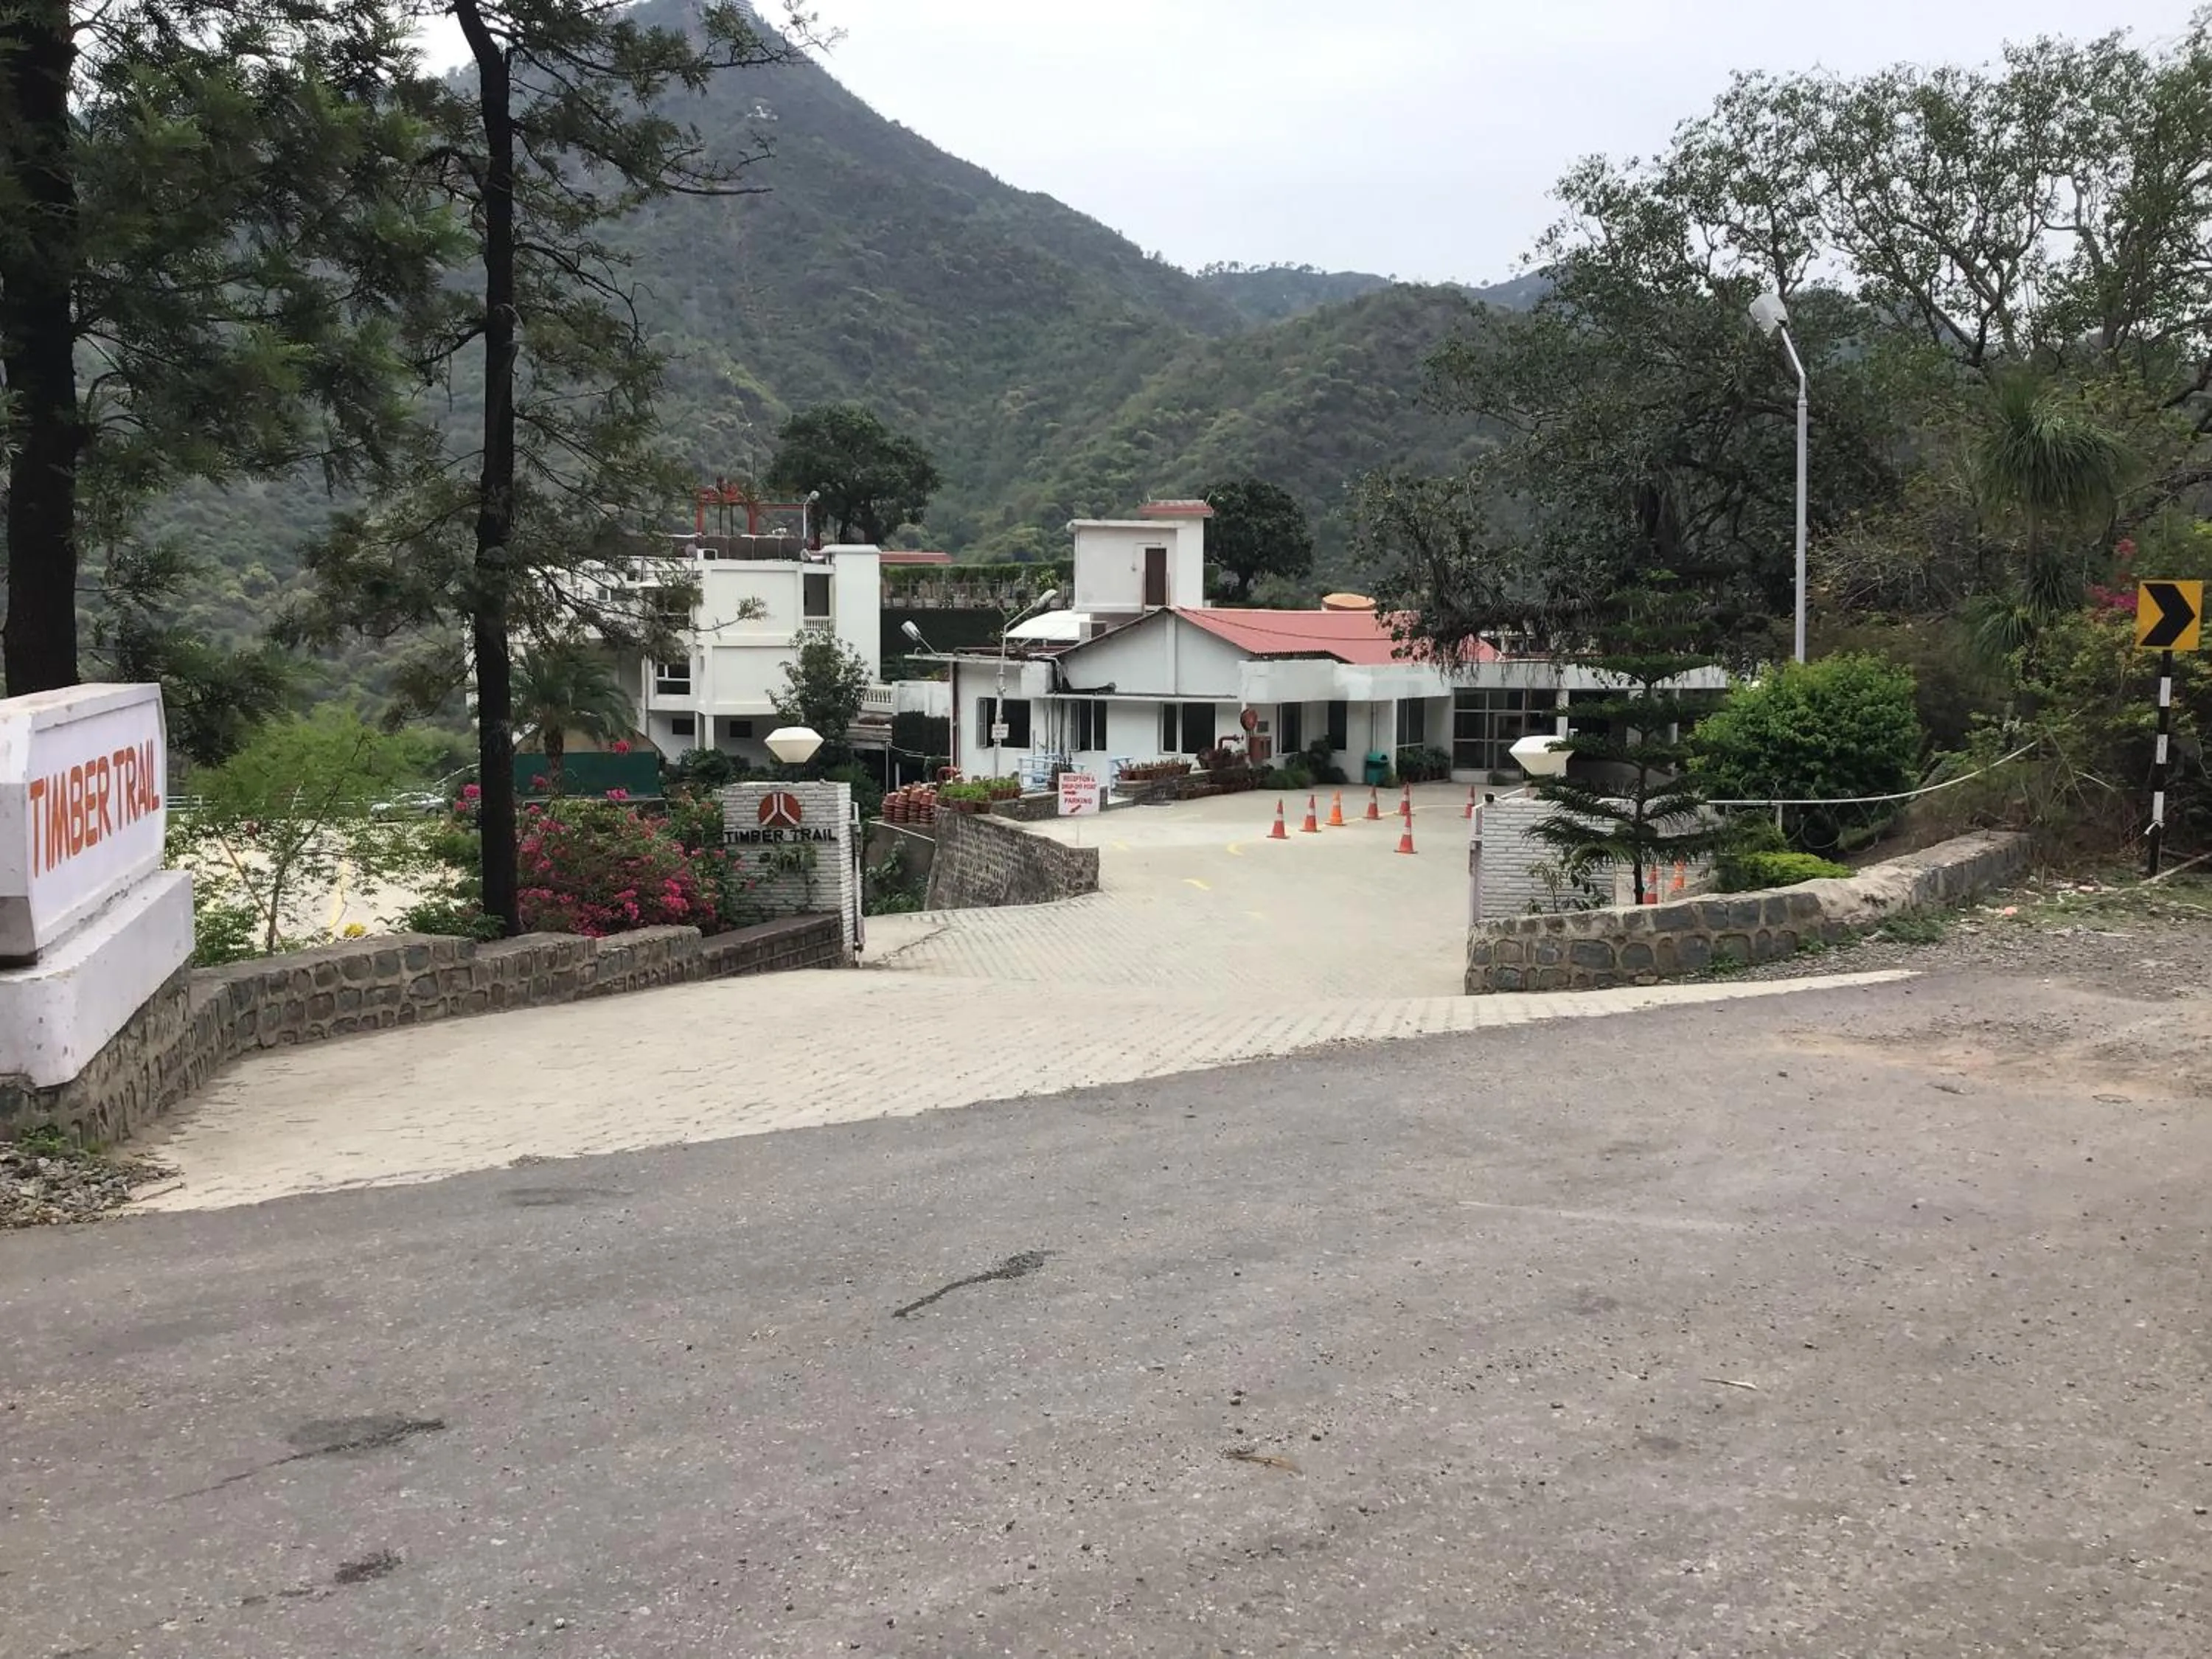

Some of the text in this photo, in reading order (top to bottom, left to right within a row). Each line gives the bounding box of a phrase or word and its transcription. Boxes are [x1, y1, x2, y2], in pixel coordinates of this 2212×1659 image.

[29, 738, 159, 878] TIMBER TRAIL
[724, 828, 838, 844] TIMBER TRAIL
